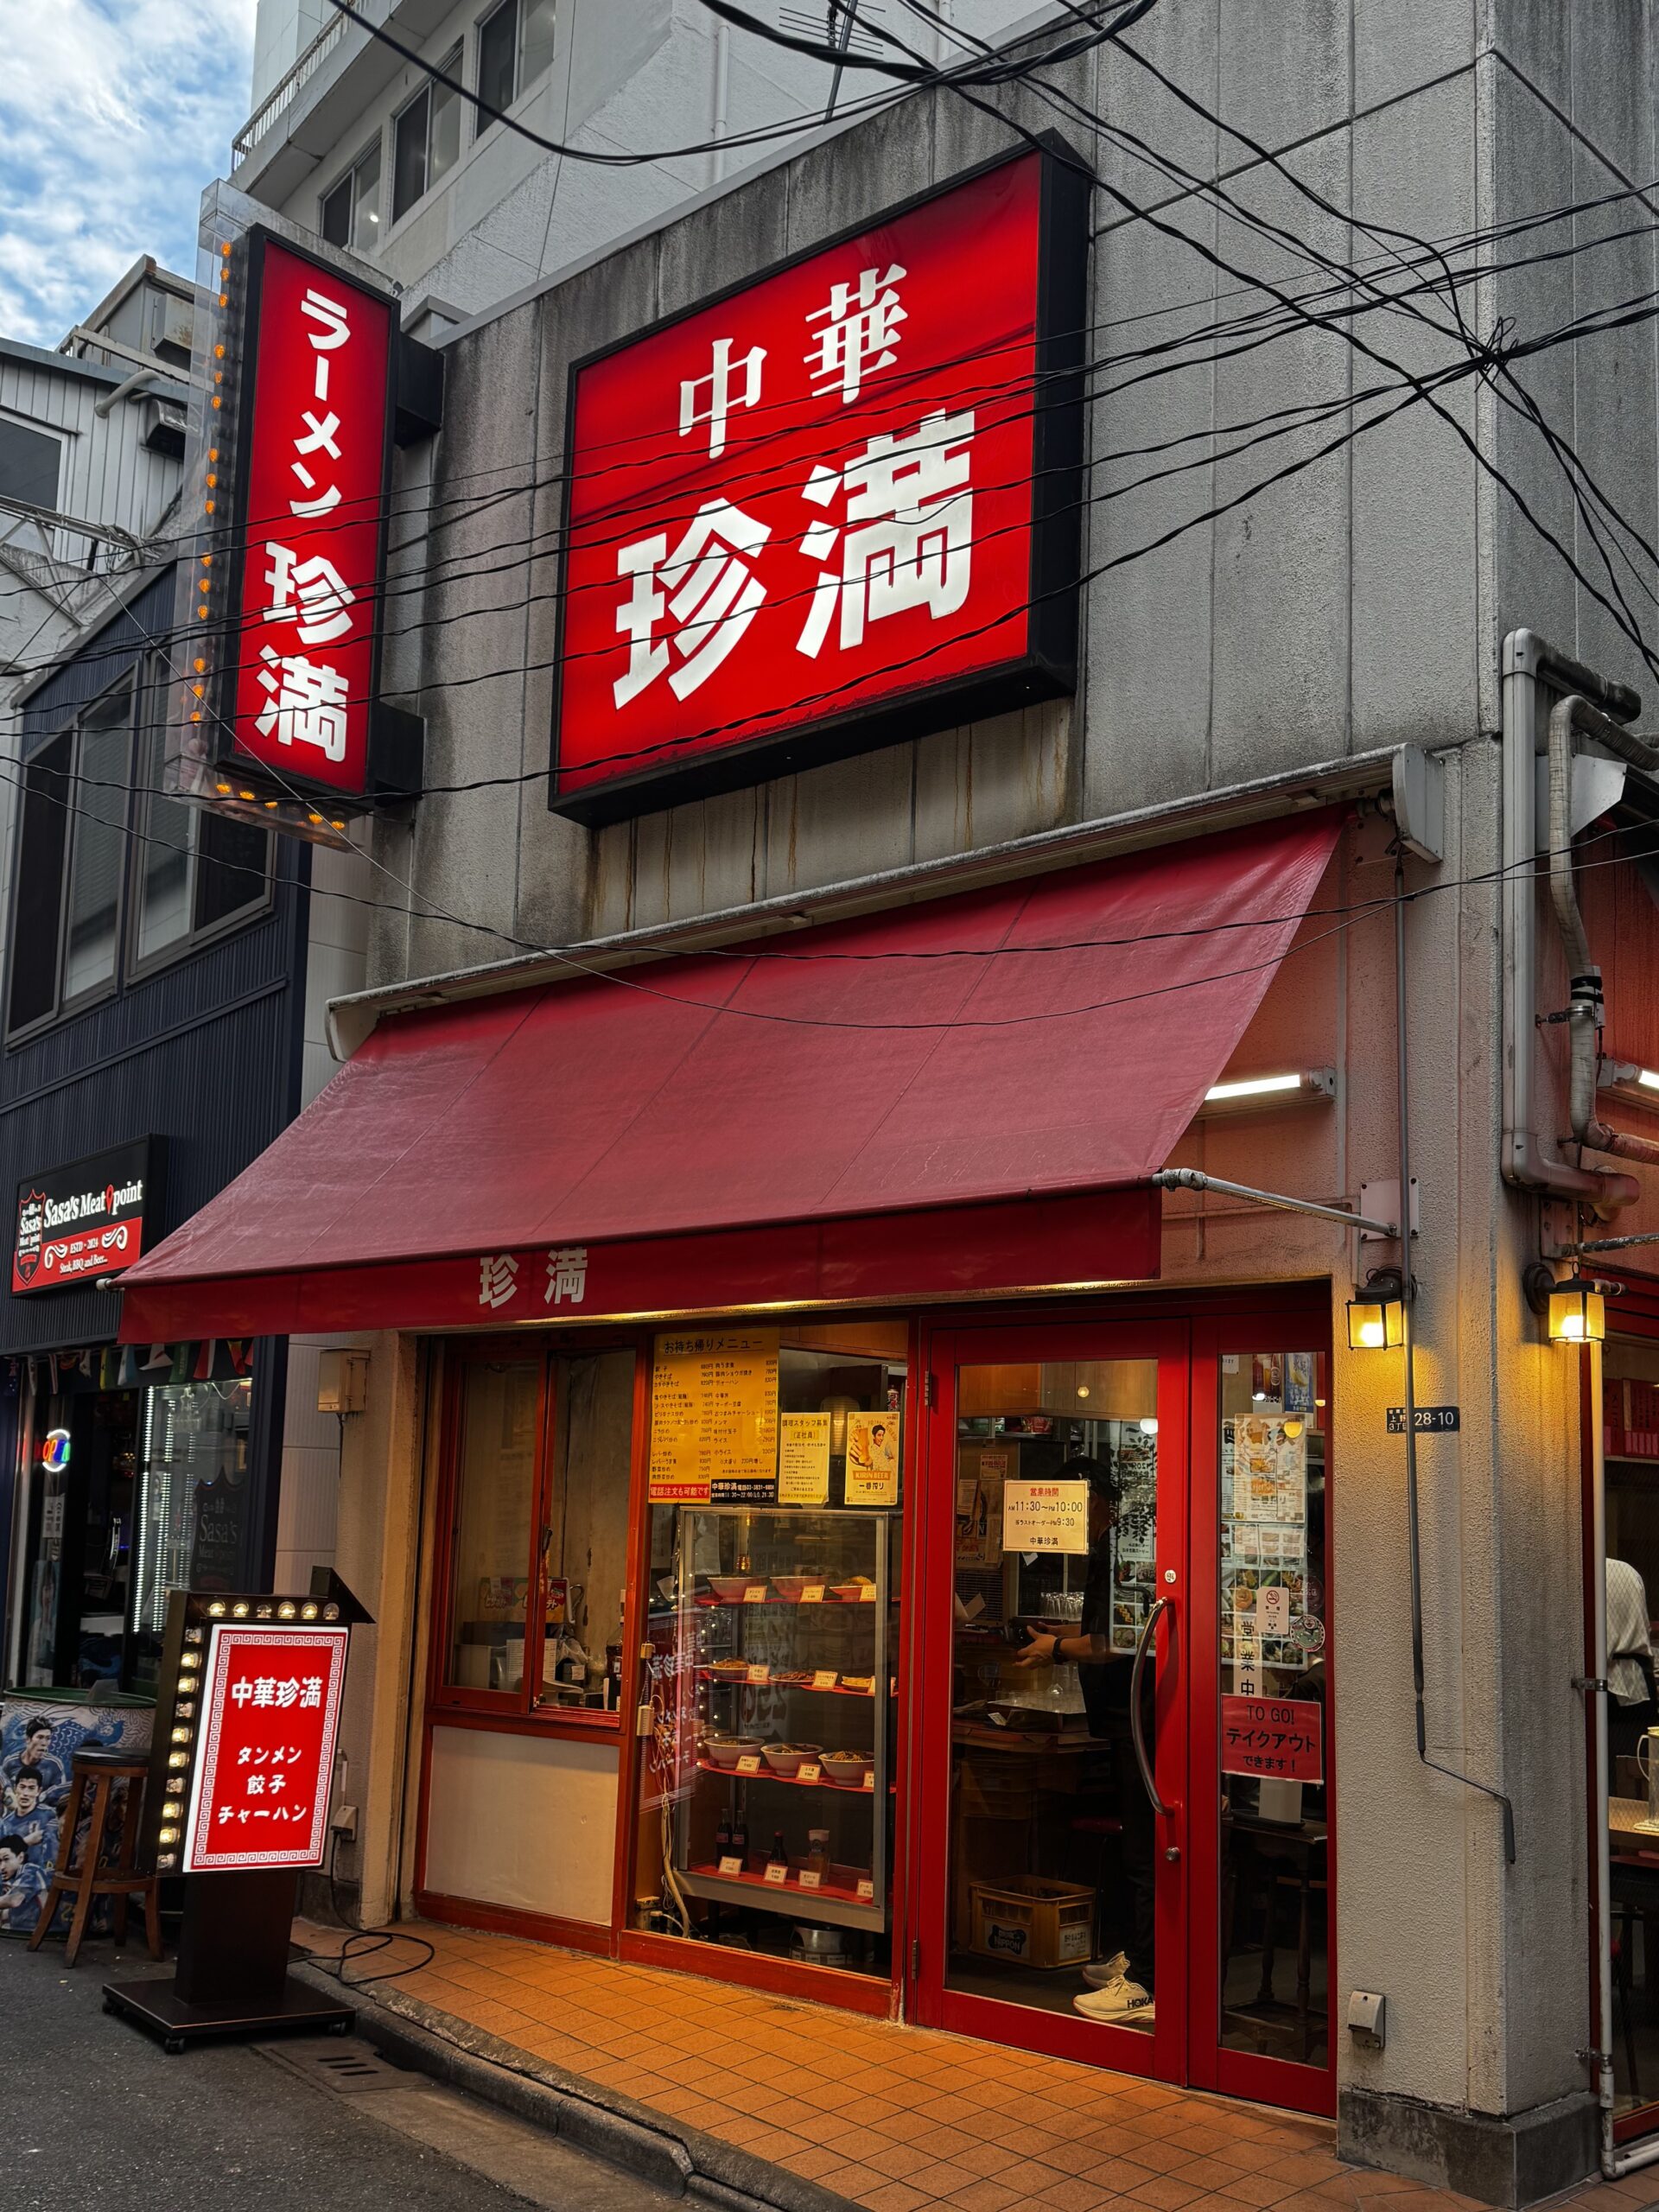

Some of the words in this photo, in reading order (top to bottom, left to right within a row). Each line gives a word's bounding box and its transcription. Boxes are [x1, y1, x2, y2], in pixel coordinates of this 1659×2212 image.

[679, 263, 907, 460] 中華
[289, 288, 351, 518] ラーメン
[613, 407, 975, 709] 珍満
[256, 541, 355, 763] 珍満
[43, 1195, 79, 1228] Sasa's
[79, 1192, 105, 1217] Meat
[111, 1179, 143, 1215] point
[479, 1247, 588, 1309] 珍満
[664, 1338, 763, 1354] お持ち帰りメニュー
[1414, 1412, 1454, 1426] 28-10
[42, 1439, 71, 1463] OPEN
[650, 1486, 709, 1497] 電話注文も可能です
[1029, 1487, 1059, 1497] 営業時間
[1030, 1536, 1058, 1545] 中華珍満
[1240, 1620, 1255, 1695] 営業中
[231, 1675, 323, 1709] 中華珍満
[1246, 1705, 1265, 1721] TO
[1270, 1707, 1294, 1726] GO!
[1226, 1727, 1315, 1752] テイクアウト
[237, 1745, 302, 1765] タンメン
[247, 1774, 286, 1796] 餃子
[218, 1805, 307, 1825] チャーハン
[1127, 1995, 1154, 2008] HOKA
